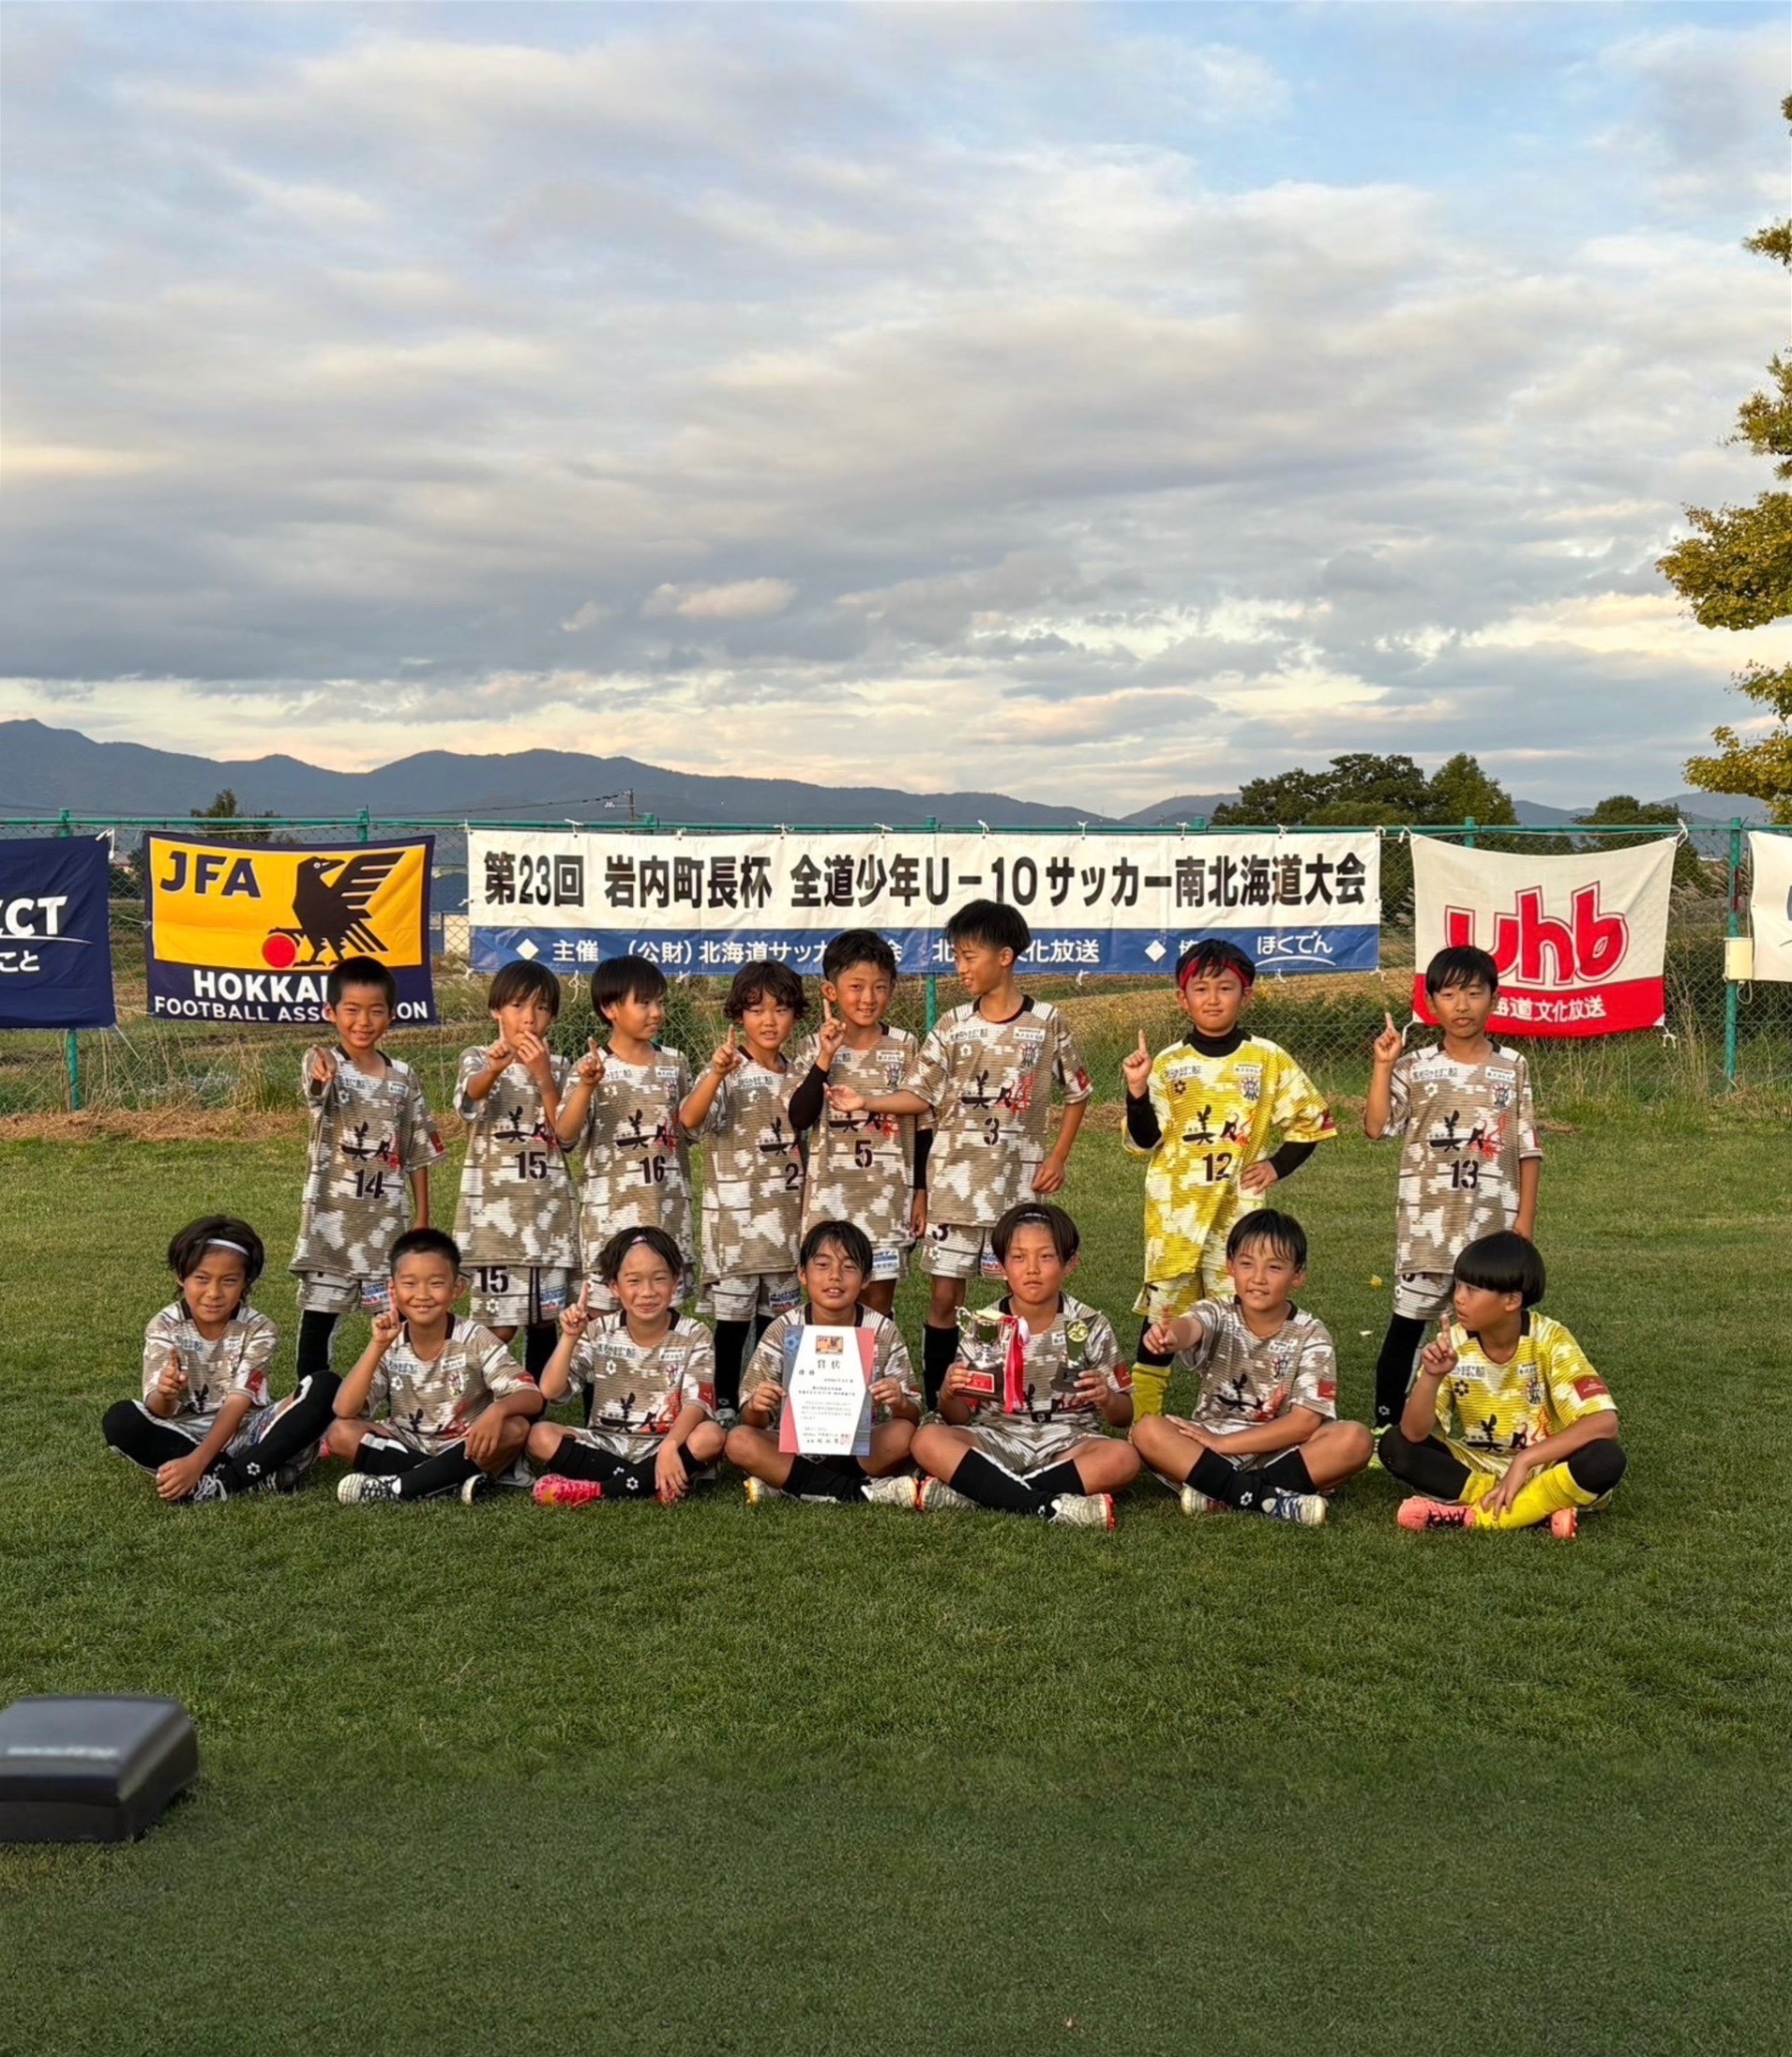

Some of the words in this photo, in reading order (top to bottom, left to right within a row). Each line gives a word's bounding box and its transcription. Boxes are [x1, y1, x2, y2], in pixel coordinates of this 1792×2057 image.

[160, 850, 262, 898] JFA
[484, 851, 585, 908] 第23回
[605, 854, 774, 909] 岩内町長杯
[0, 895, 68, 936] CT
[552, 939, 599, 962] 主催
[1257, 930, 1333, 955] ほくでん
[1444, 880, 1630, 986] uhb
[193, 970, 328, 1003] HOKKAI
[154, 996, 270, 1021] FOOTBALL
[983, 1117, 1000, 1145] 3
[515, 1151, 548, 1179] 15
[854, 1140, 873, 1168] 5
[1202, 1152, 1233, 1182] 12
[640, 1155, 666, 1184] 16
[785, 1162, 799, 1190] 2
[1451, 1159, 1479, 1189] 13
[354, 1170, 384, 1199] 14
[477, 1267, 509, 1293] 15
